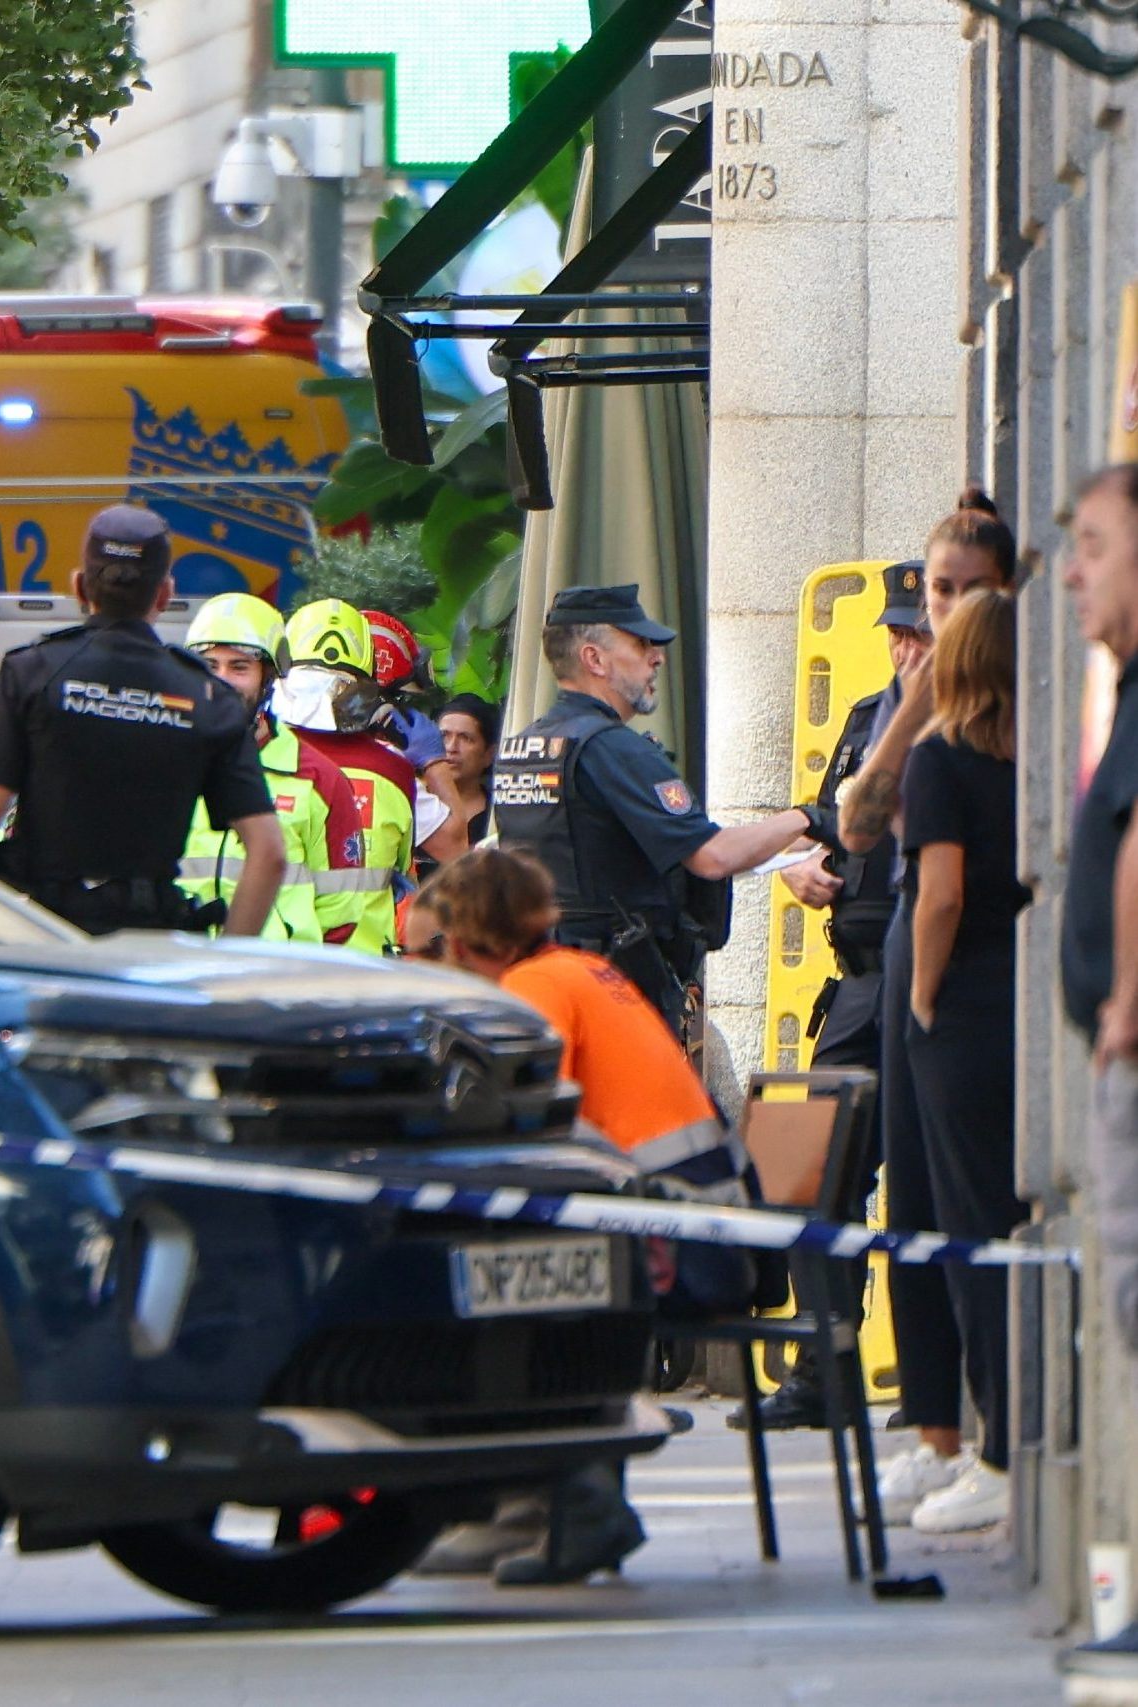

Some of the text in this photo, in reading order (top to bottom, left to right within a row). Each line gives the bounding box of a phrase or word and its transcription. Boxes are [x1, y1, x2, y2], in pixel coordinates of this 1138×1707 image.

[712, 50, 834, 89] NDADA
[725, 107, 762, 145] EN
[718, 162, 777, 201] 1873
[63, 679, 165, 709] POLICIA
[64, 696, 194, 729] NACIONAL
[494, 773, 542, 790] POLICIA
[494, 789, 559, 804] NACIONAL
